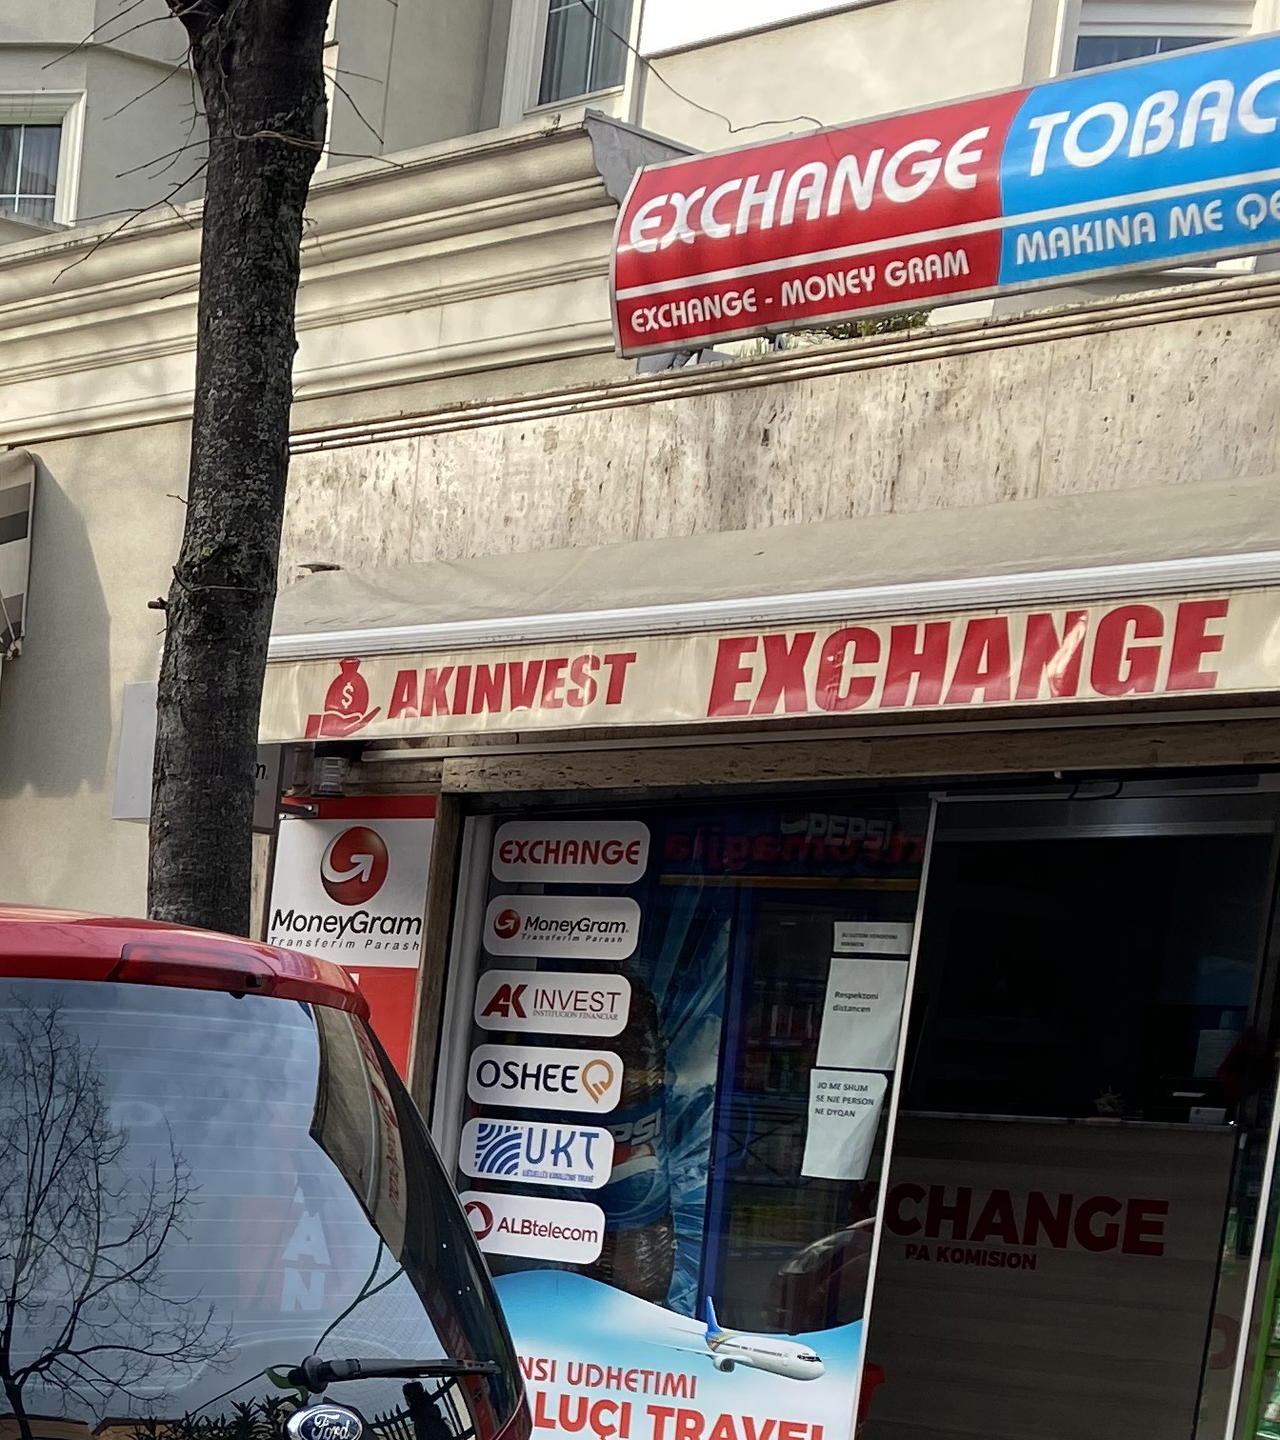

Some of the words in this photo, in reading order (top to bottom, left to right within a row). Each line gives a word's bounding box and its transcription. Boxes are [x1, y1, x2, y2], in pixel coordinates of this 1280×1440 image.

[1027, 70, 1280, 176] TOBAC
[630, 126, 991, 254] EXCHANGE
[1016, 210, 1157, 265] MAKINA
[1169, 198, 1224, 240] ME
[630, 289, 758, 334] EXCHANGE
[780, 265, 876, 308] MONEY
[884, 247, 970, 288] GRAM
[388, 651, 637, 720] AKINVEST
[707, 597, 1230, 717] EXCHANGE
[499, 839, 641, 866] EXCHANGE
[270, 908, 422, 938] MoneyGram
[524, 916, 626, 935] MoneyGram
[585, 935, 623, 943] Parash
[269, 935, 357, 951] Transferim
[364, 939, 421, 952] Parash
[481, 983, 529, 1019] AK
[534, 989, 622, 1013] INVEST
[476, 1060, 579, 1094] OSHEE
[842, 1097, 875, 1106] PERSON
[525, 1127, 600, 1169] UKT
[497, 1215, 598, 1244] ALBtelecom
[905, 1244, 930, 1261] PA
[936, 1246, 1038, 1271] KOMISION
[567, 1361, 697, 1398] UDHETIMI
